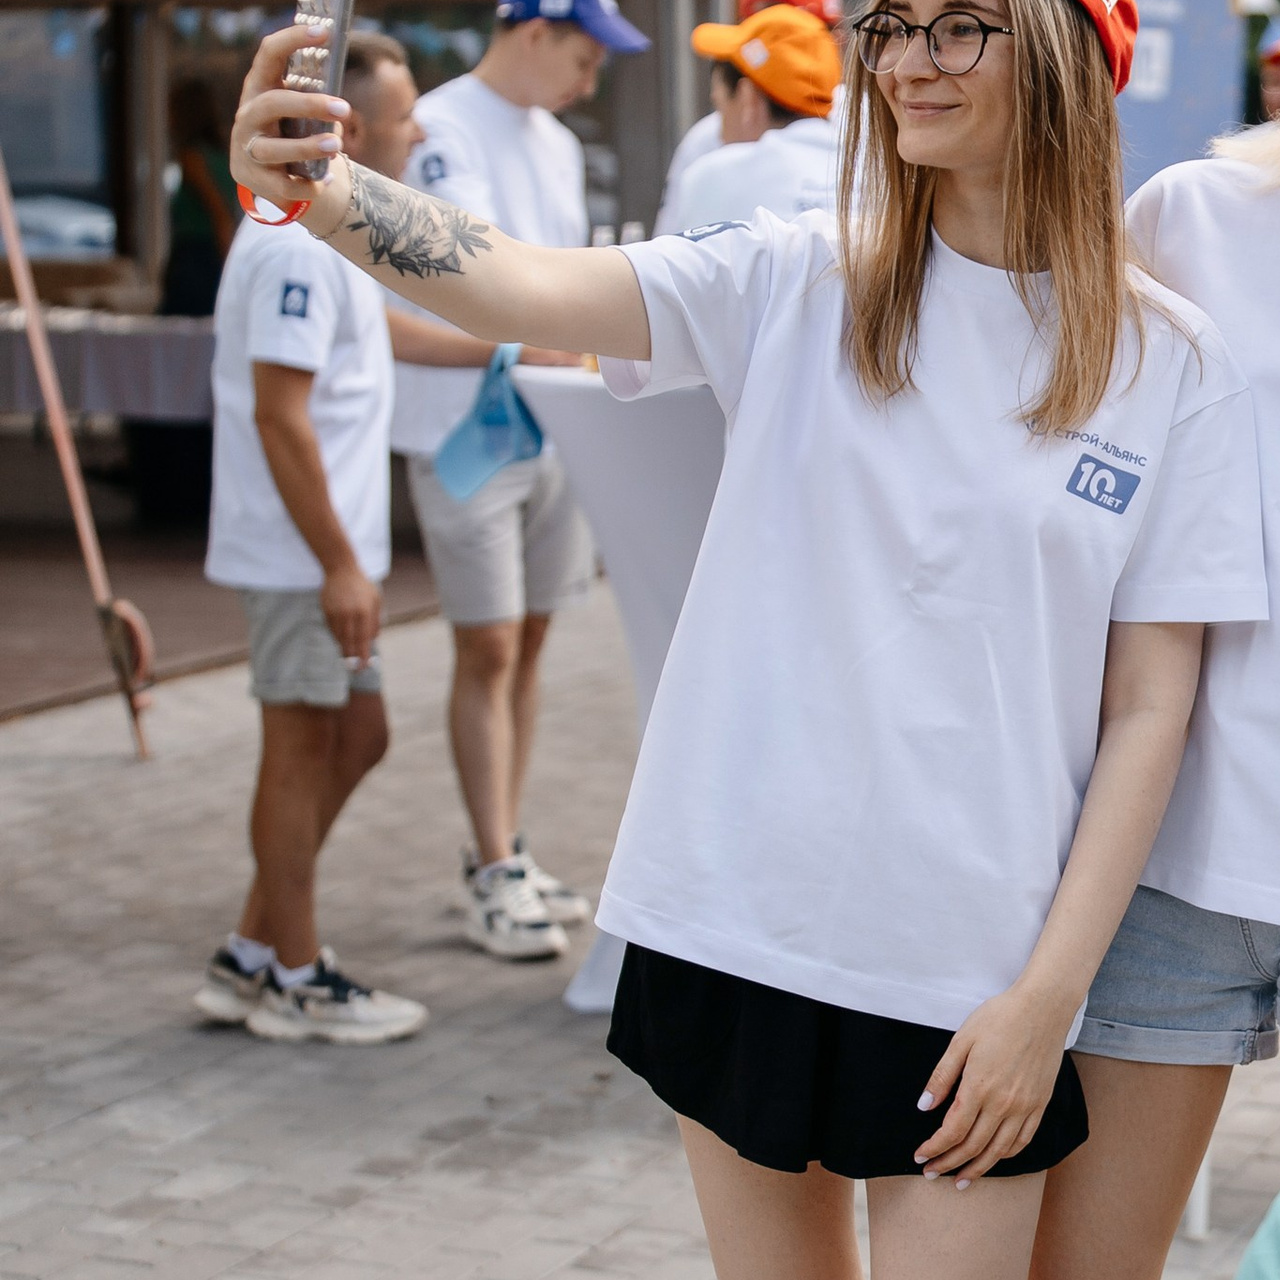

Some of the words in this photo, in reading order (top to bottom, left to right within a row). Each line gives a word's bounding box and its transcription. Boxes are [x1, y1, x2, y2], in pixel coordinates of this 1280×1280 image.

[1053, 427, 1148, 467] СТРОЙ-АЛЬЯНС
[1076, 461, 1117, 499] 10
[1098, 493, 1123, 509] ЛЕТ
